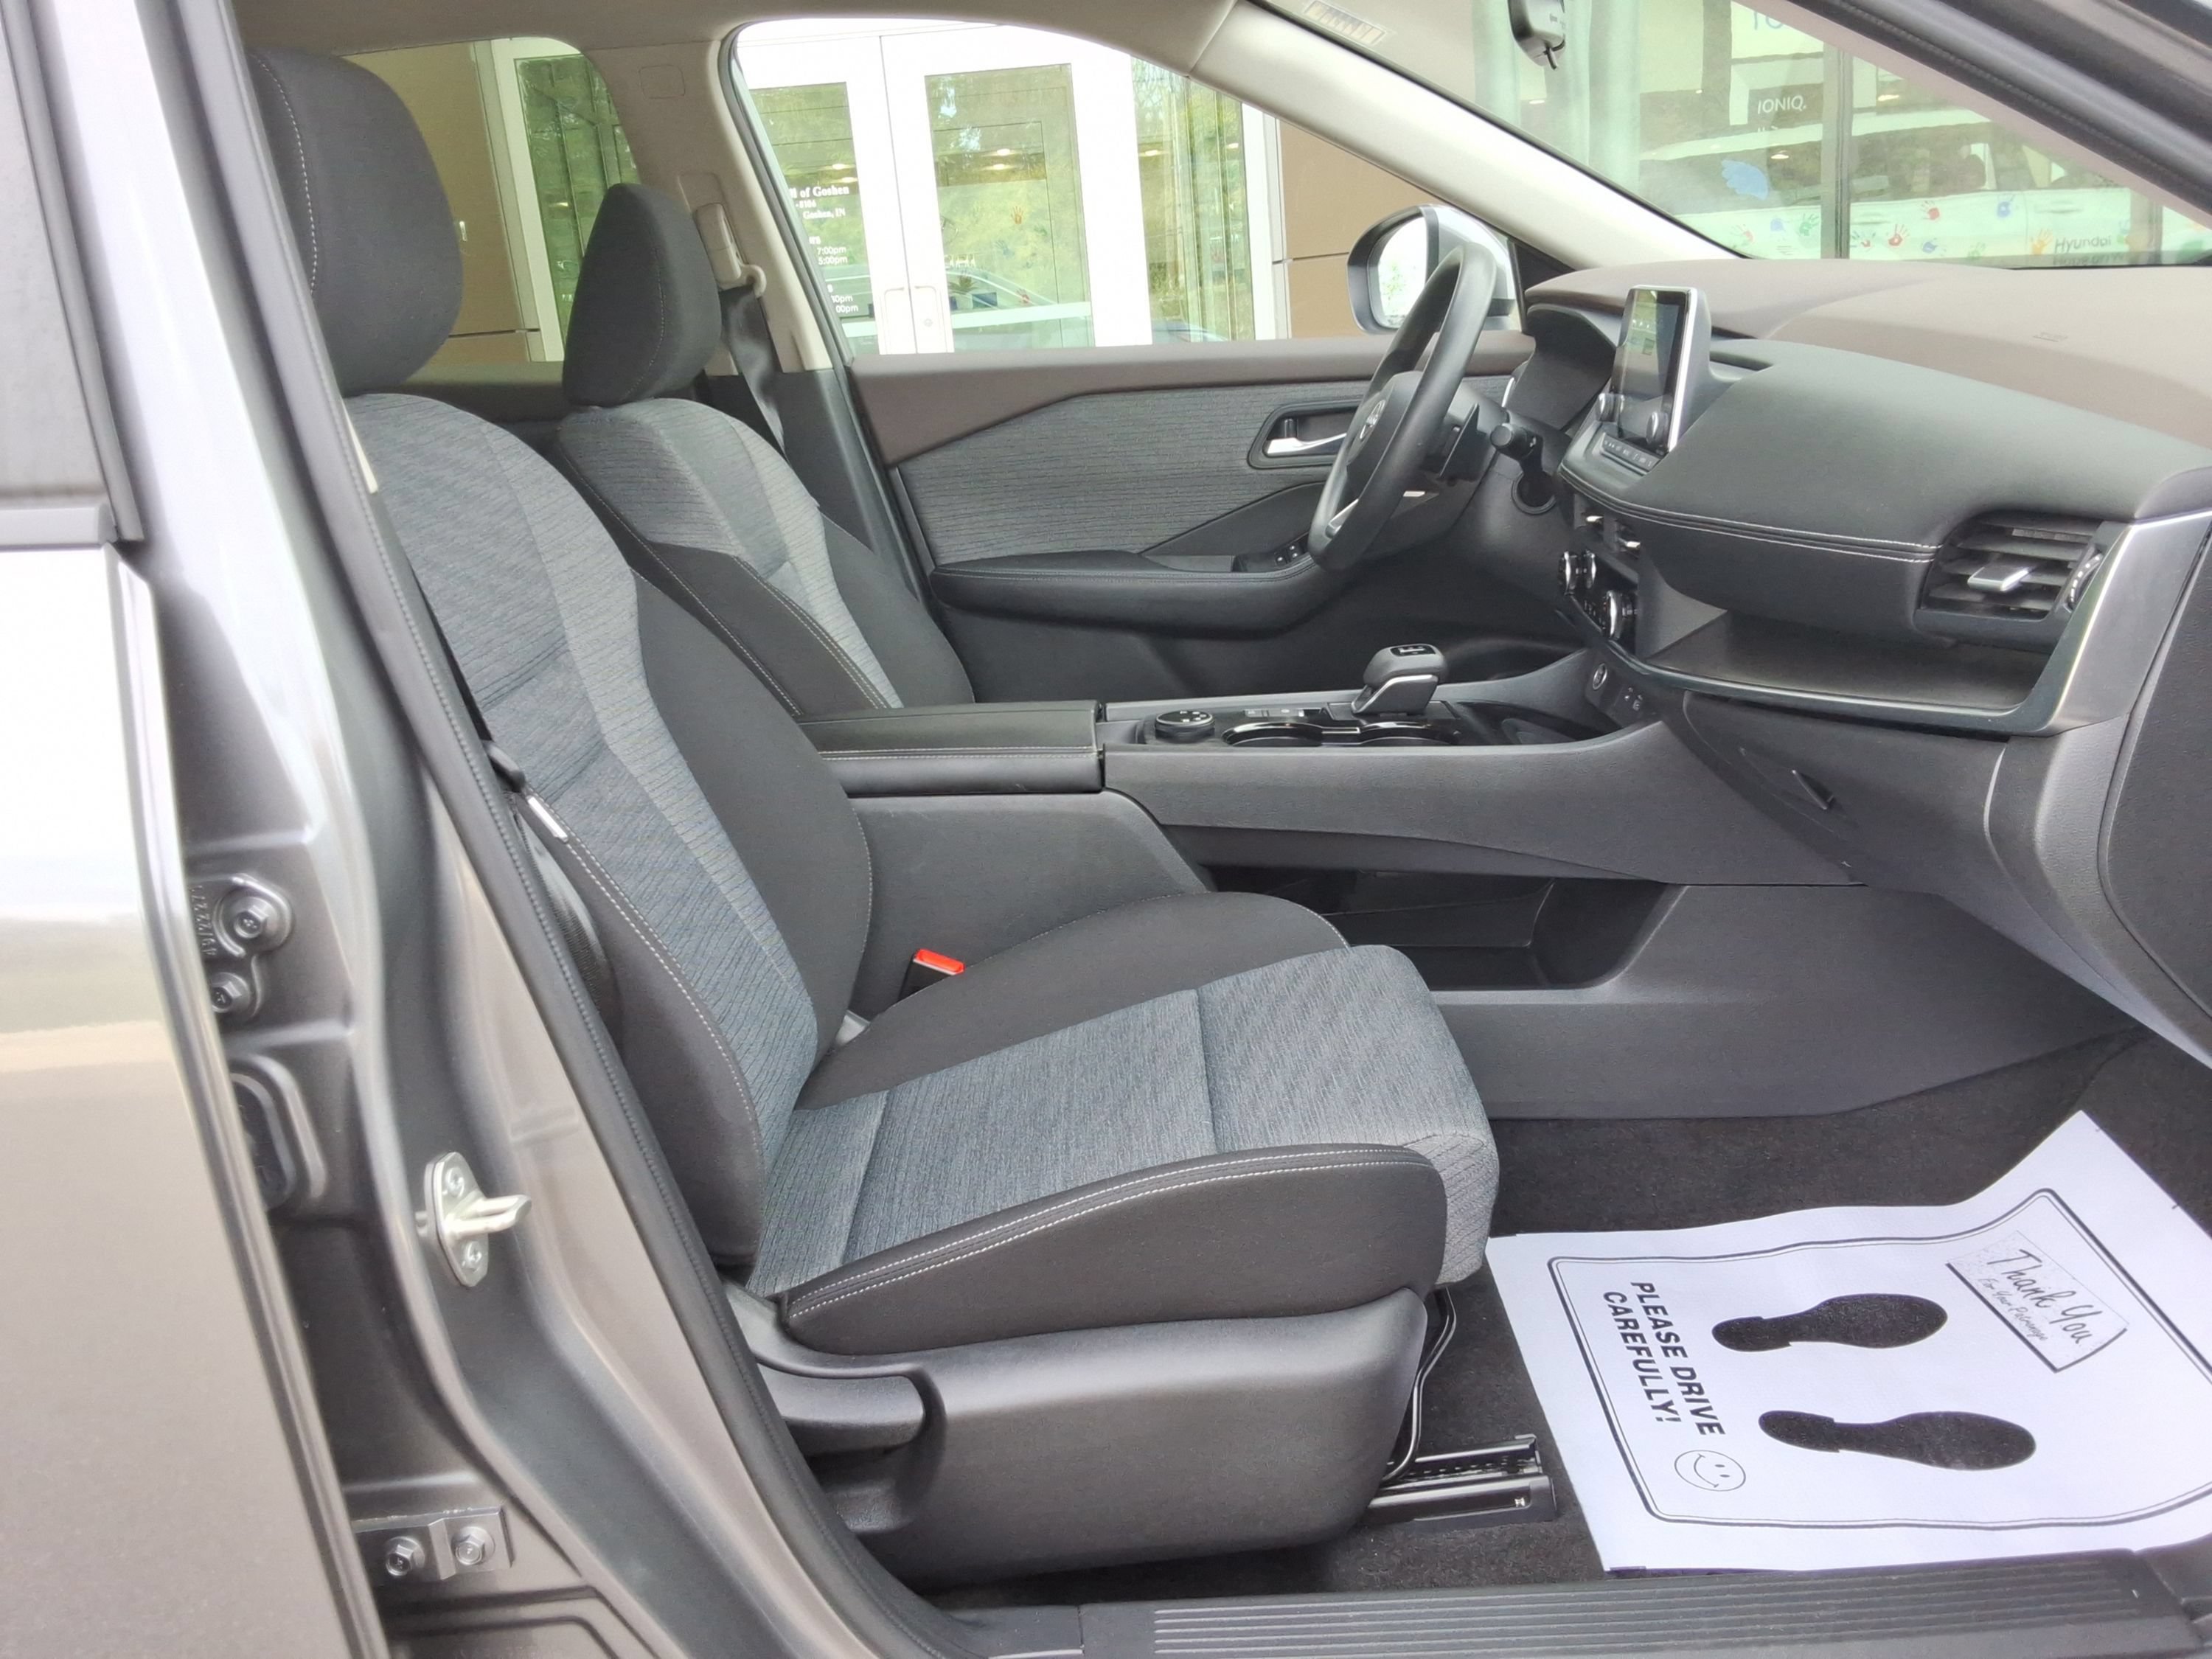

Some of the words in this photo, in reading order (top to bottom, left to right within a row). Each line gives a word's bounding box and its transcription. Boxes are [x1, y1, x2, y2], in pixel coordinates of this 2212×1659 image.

[799, 187, 810, 198] of
[812, 185, 849, 197] Goshen
[817, 246, 846, 256] 7:00pm
[2053, 235, 2112, 254] Hyundai
[818, 256, 848, 265] 5:00pm
[1986, 1248, 2077, 1308] Thank
[2048, 1304, 2104, 1344] You
[1603, 1291, 1682, 1422] CAREFULLY!
[1630, 1281, 1688, 1358] PLEASE
[1669, 1366, 1726, 1436] DRIVE
